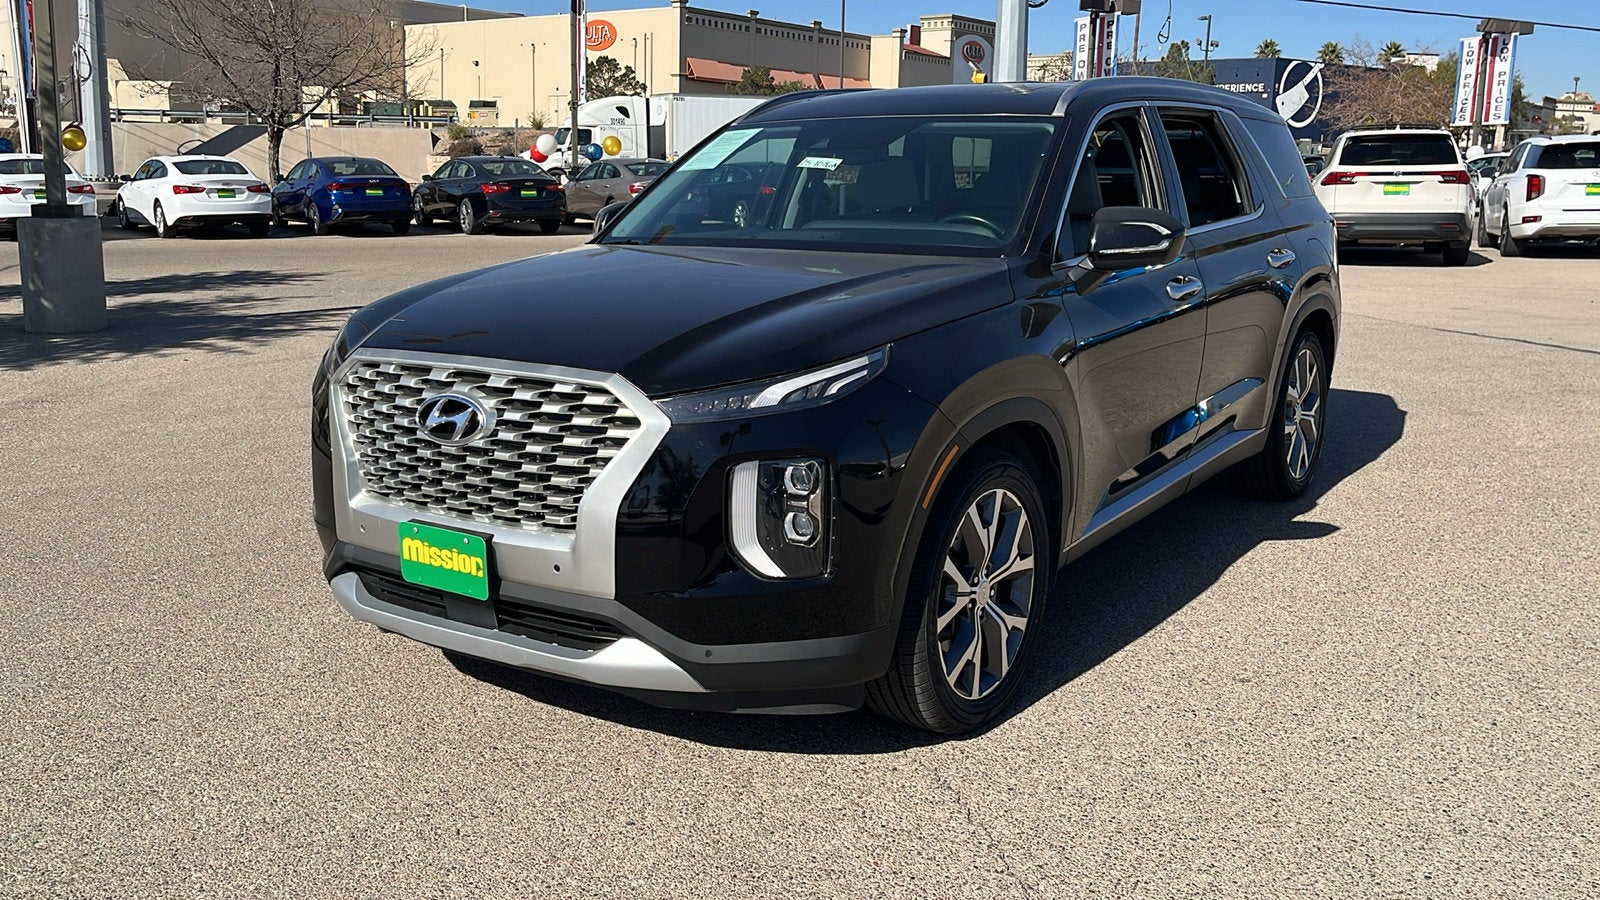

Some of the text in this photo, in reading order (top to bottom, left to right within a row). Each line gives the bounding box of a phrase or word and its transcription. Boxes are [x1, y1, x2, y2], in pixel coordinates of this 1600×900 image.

[586, 25, 612, 42] ULTA
[1079, 23, 1087, 53] PRE
[1106, 20, 1114, 50] PRE
[1458, 42, 1475, 122] LOW PRICES
[1492, 38, 1509, 120] LOW PRICES
